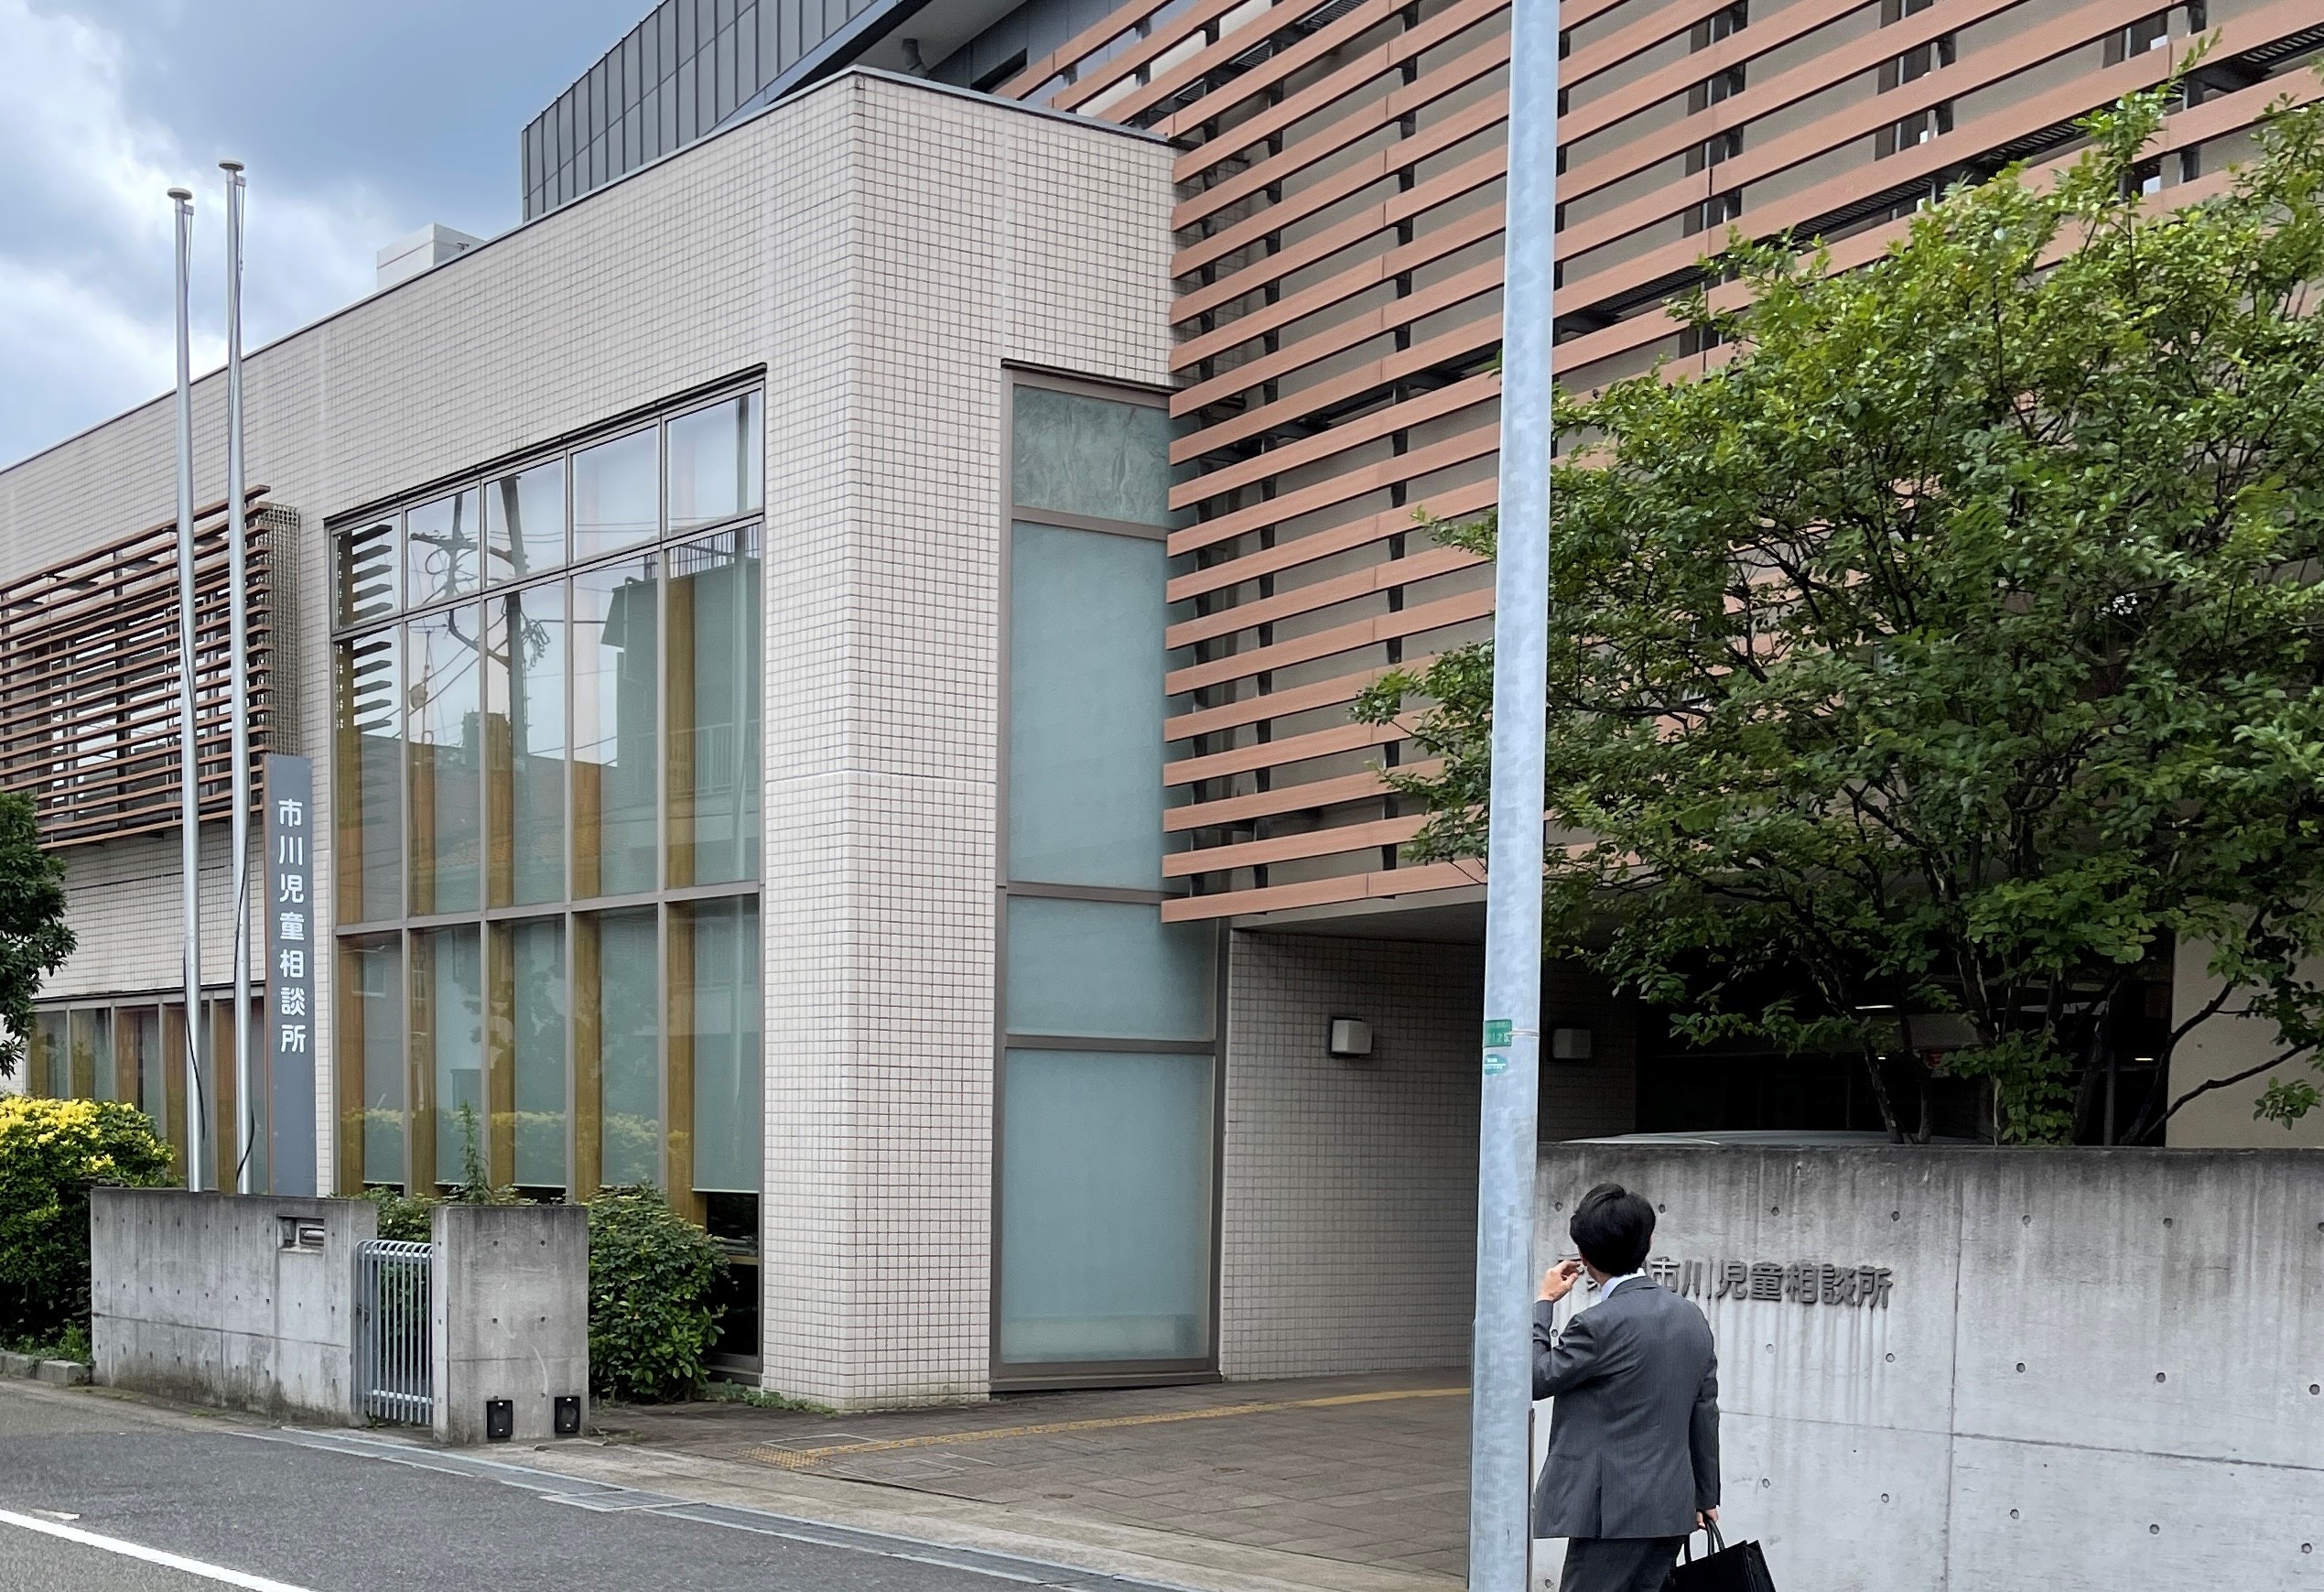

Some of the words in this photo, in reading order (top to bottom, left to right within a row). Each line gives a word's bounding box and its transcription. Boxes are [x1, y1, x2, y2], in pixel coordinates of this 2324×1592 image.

[278, 798, 306, 1053] 市川児童相談所
[1557, 1254, 1894, 1309] 市川児童相談所
